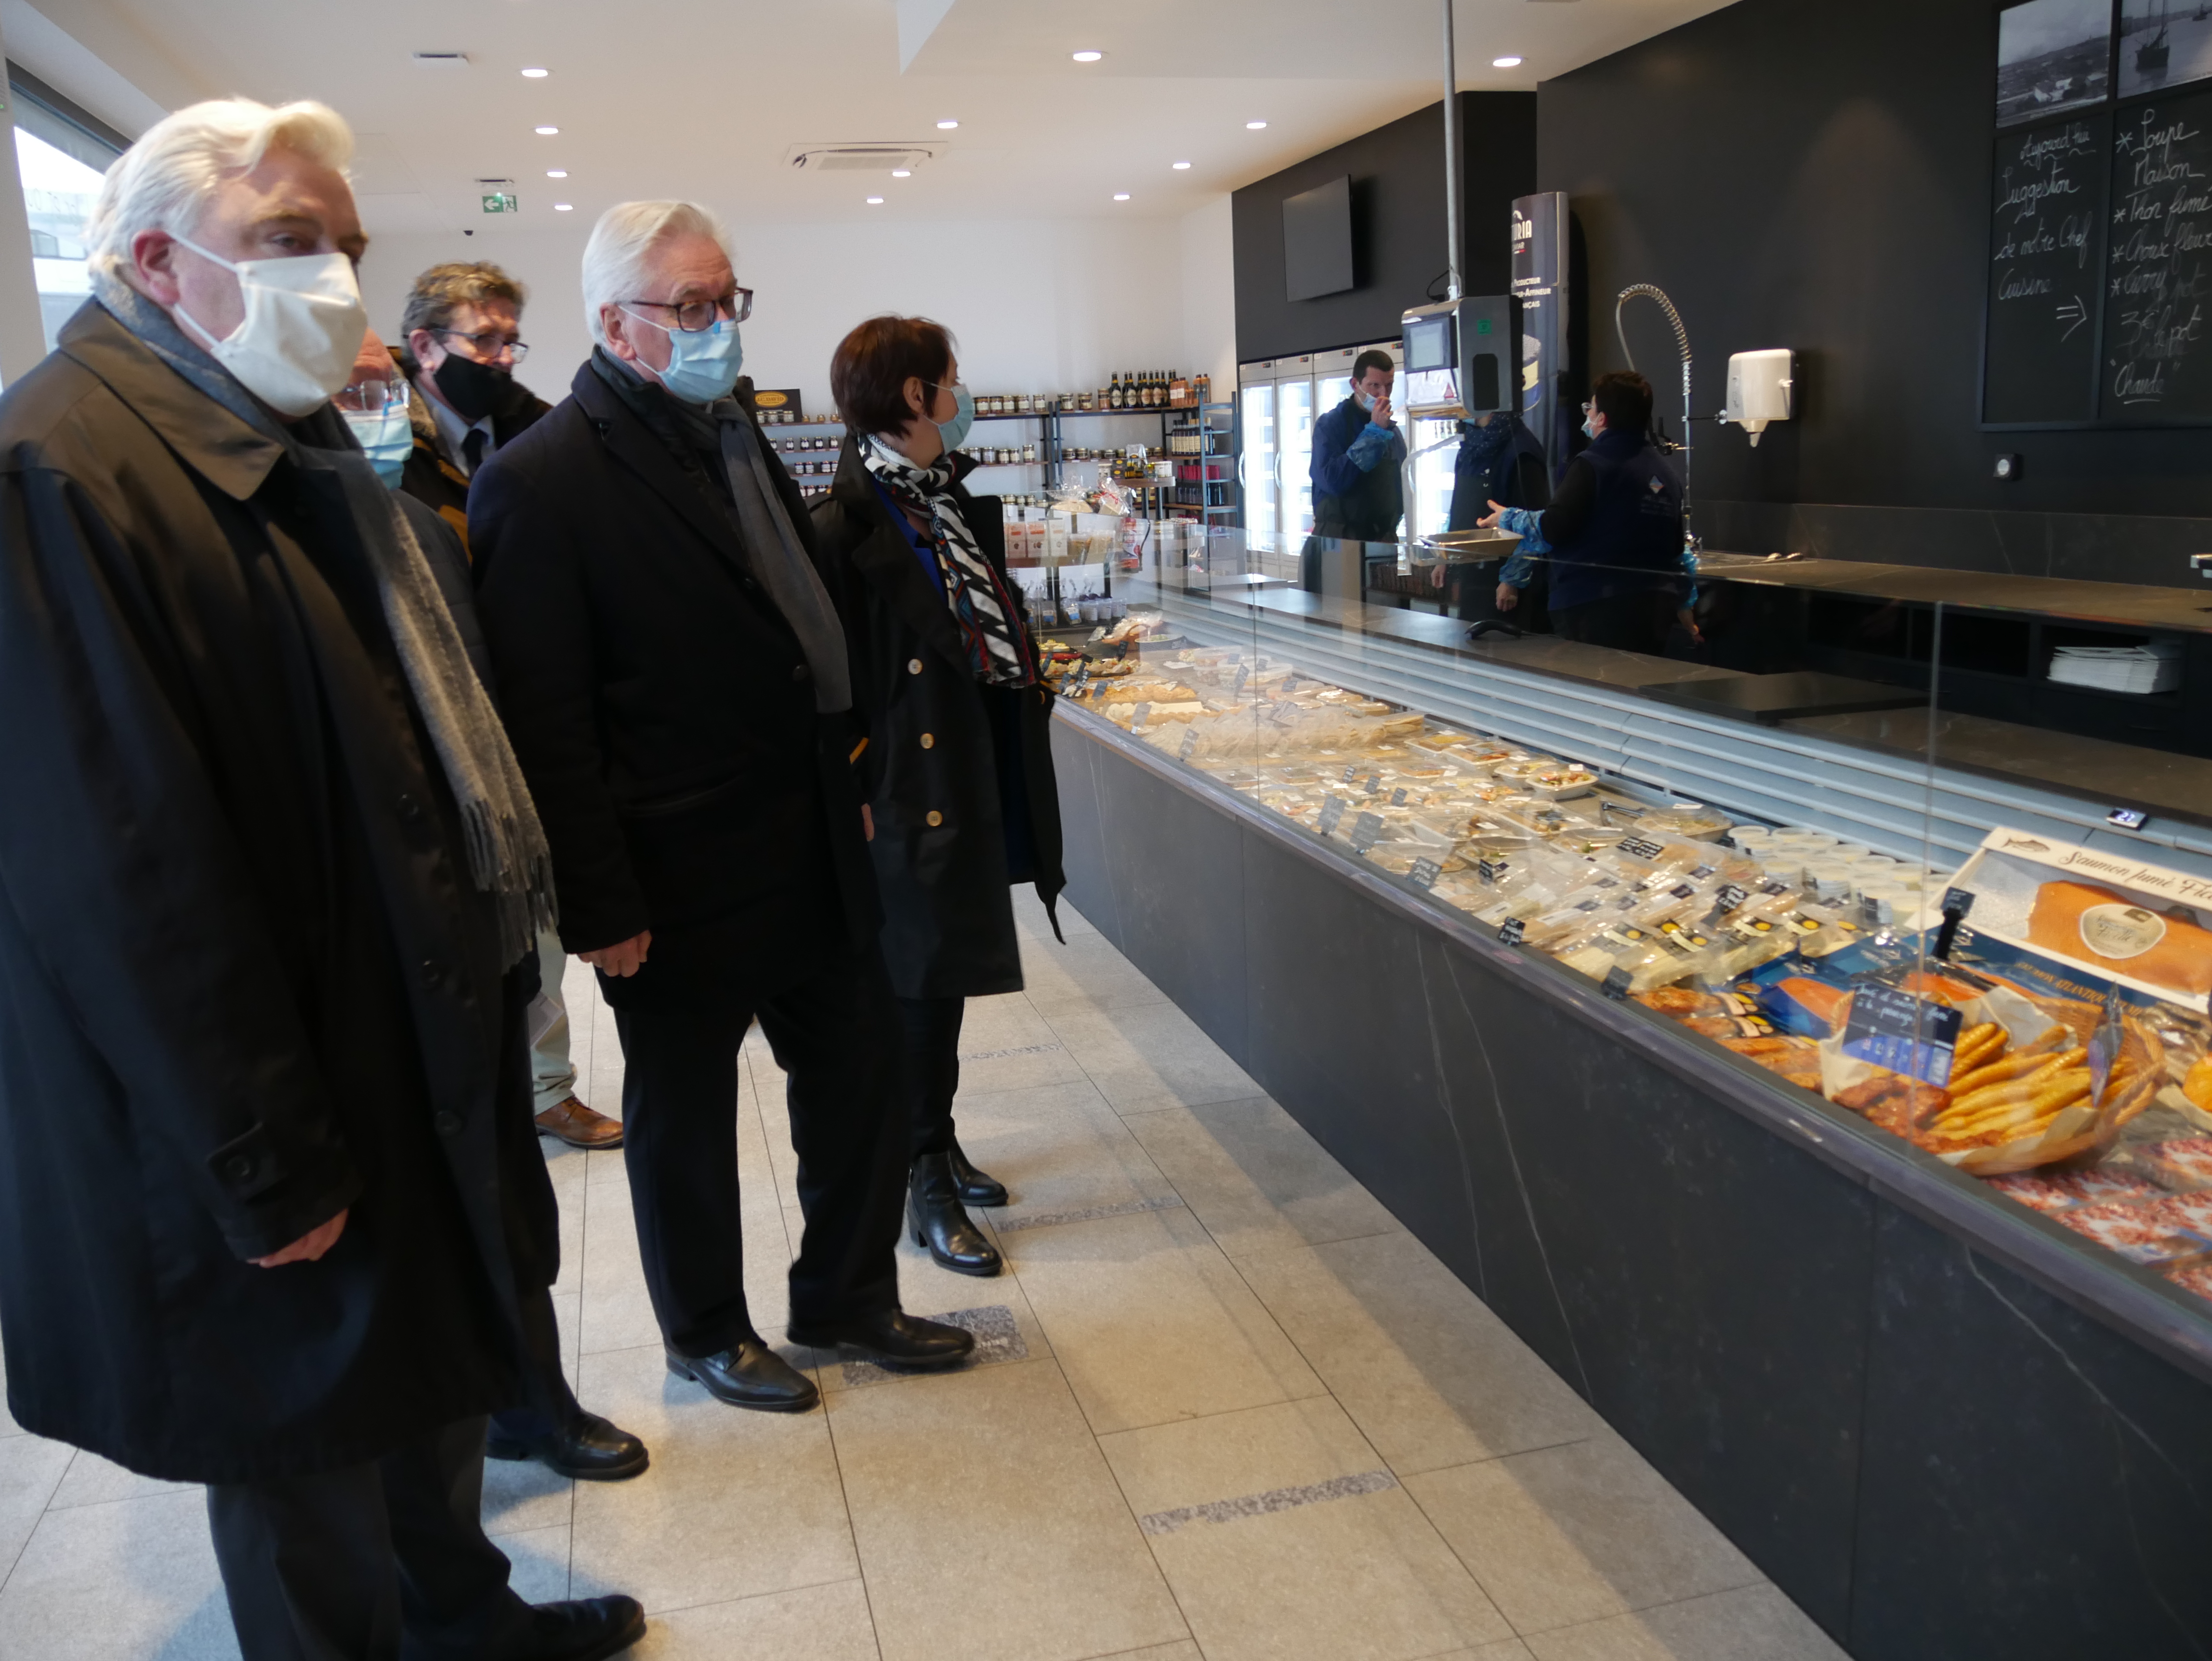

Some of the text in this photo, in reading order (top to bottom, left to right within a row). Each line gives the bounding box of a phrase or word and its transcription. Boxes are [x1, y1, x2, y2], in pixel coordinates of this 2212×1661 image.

[2130, 109, 2199, 164] Soupe
[2134, 153, 2206, 186] Maison
[1512, 220, 1532, 241] URIA
[1994, 211, 2094, 269] de notre Chef
[1999, 268, 2053, 301] Cuisine
[2058, 851, 2130, 876] Saumon
[2124, 869, 2176, 888] fumé
[2055, 978, 2108, 1003] ATLANTIQU
